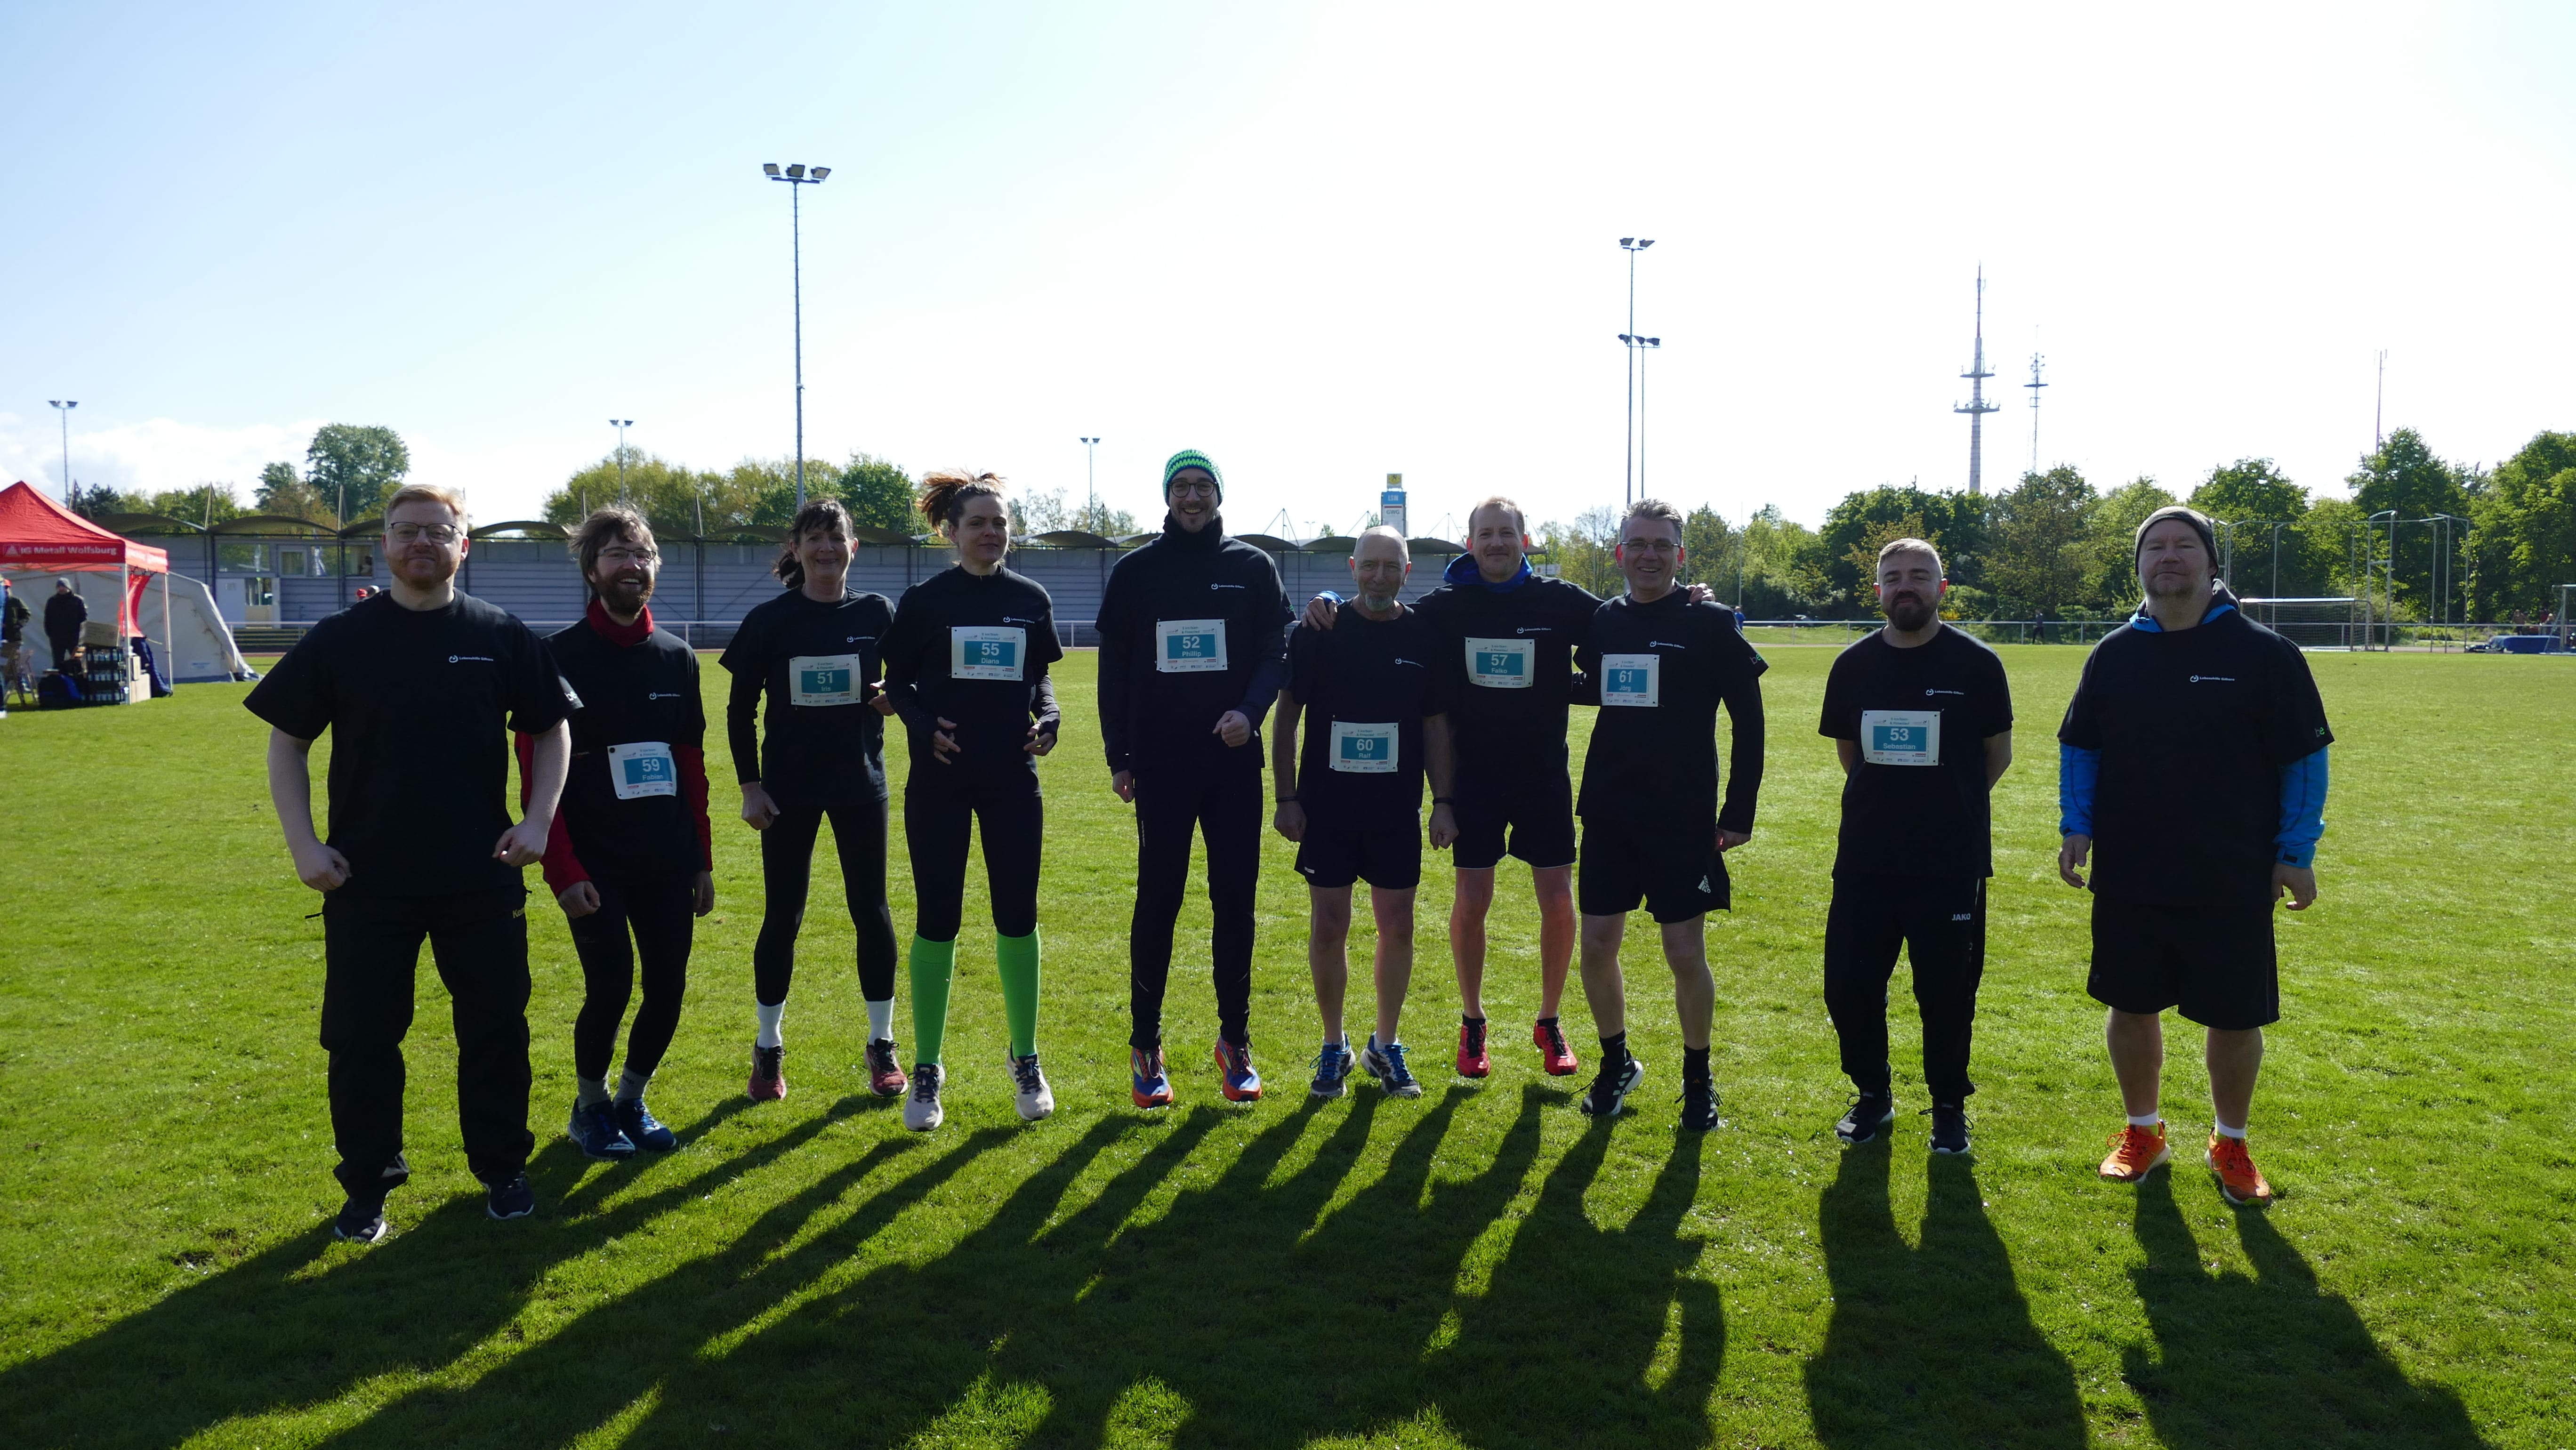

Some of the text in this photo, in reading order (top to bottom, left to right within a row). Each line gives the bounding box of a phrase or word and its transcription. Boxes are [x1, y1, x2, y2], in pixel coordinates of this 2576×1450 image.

[34, 546, 65, 554] Metall
[68, 546, 117, 556] Wolfsburg
[1182, 636, 1200, 649] 52
[981, 643, 999, 656] 55
[1491, 654, 1508, 666] 57
[817, 671, 833, 684] 51
[1619, 670, 1633, 683] 61
[1890, 728, 1909, 741] 53
[1356, 739, 1373, 751] 60
[642, 758, 660, 772] 59
